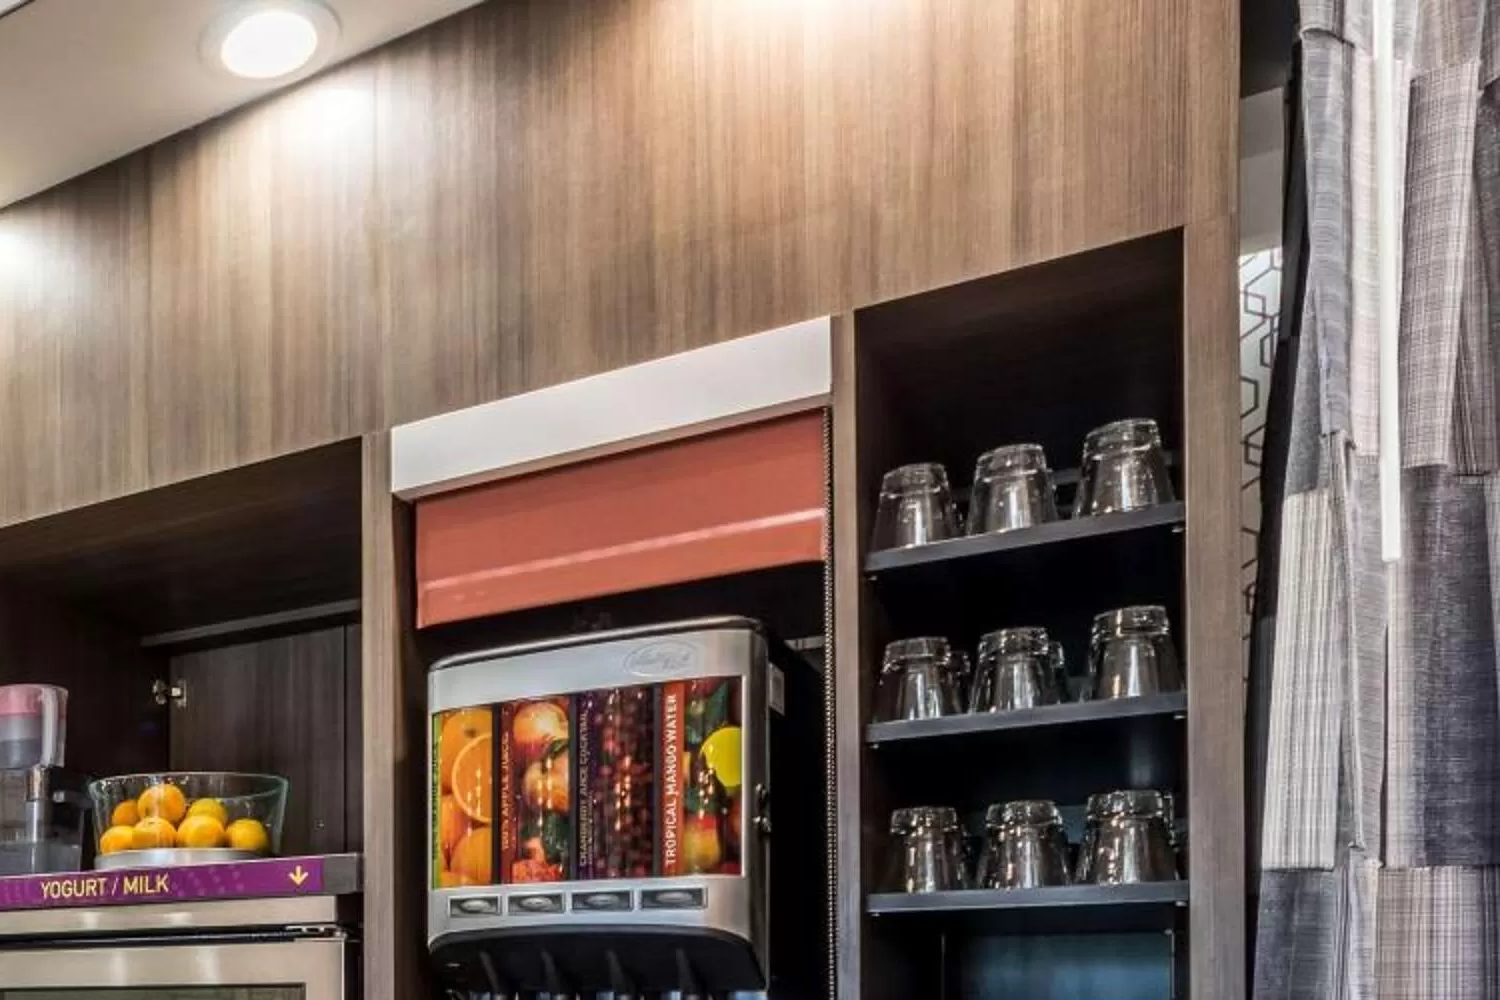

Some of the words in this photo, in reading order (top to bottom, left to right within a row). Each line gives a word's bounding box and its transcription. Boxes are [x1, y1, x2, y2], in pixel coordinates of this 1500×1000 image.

[664, 694, 677, 743] WATER
[663, 744, 677, 797] MANGO
[664, 798, 677, 868] TROPICAL
[40, 877, 107, 899] YOGURT
[123, 873, 169, 895] MILK
